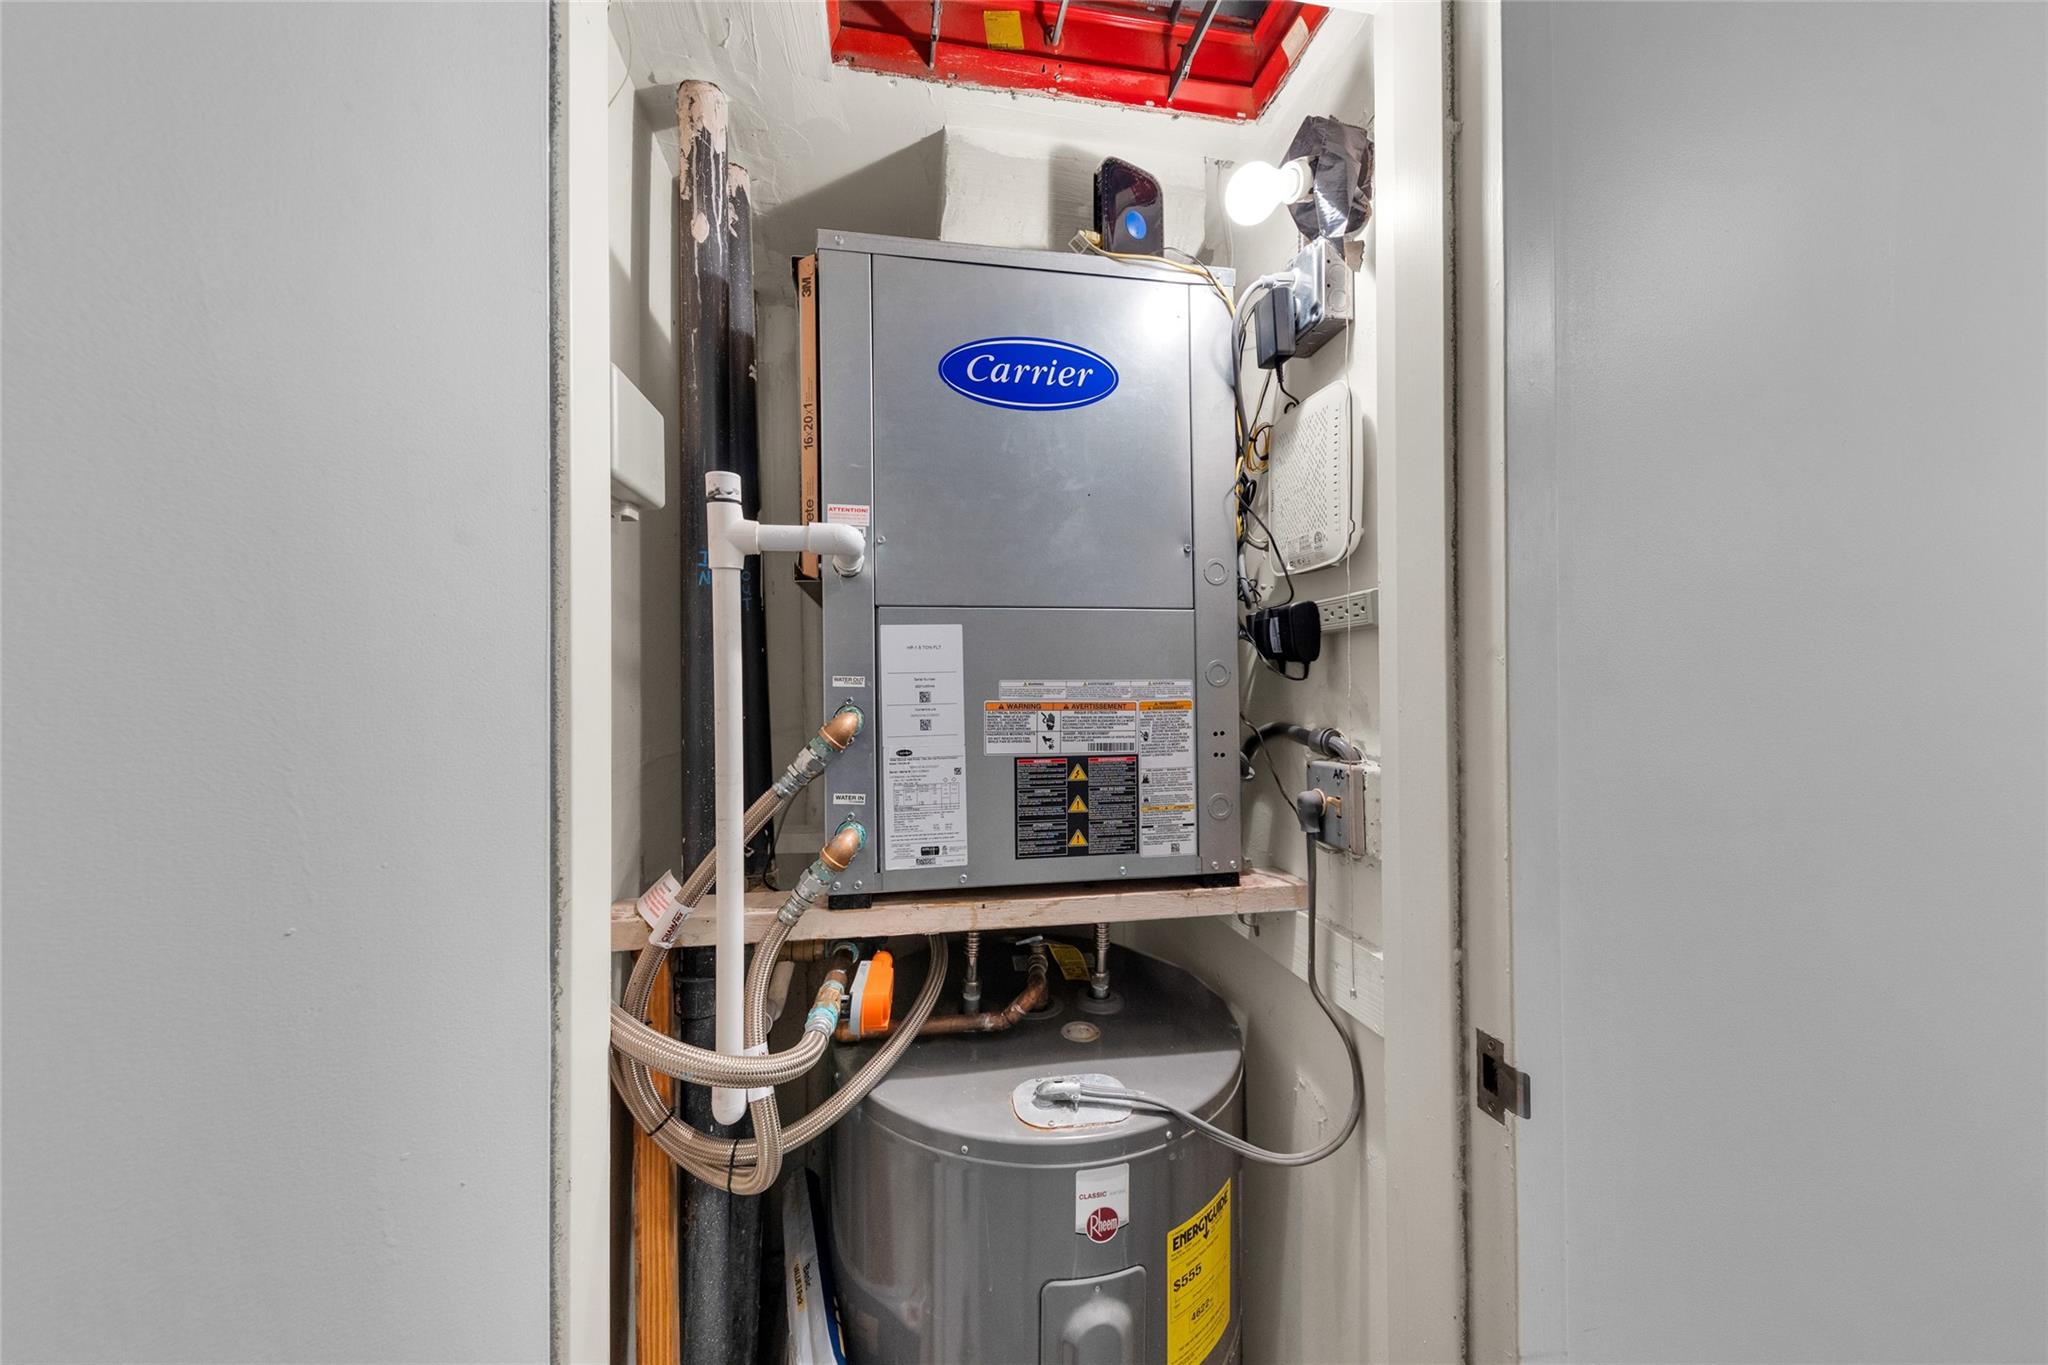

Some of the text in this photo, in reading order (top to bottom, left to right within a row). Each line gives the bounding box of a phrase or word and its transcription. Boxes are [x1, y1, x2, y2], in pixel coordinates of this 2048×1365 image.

[802, 277, 812, 298] 3M
[967, 354, 1094, 387] Carrier
[1078, 1191, 1107, 1200] CLASSIC
[1090, 1208, 1118, 1238] Rheem
